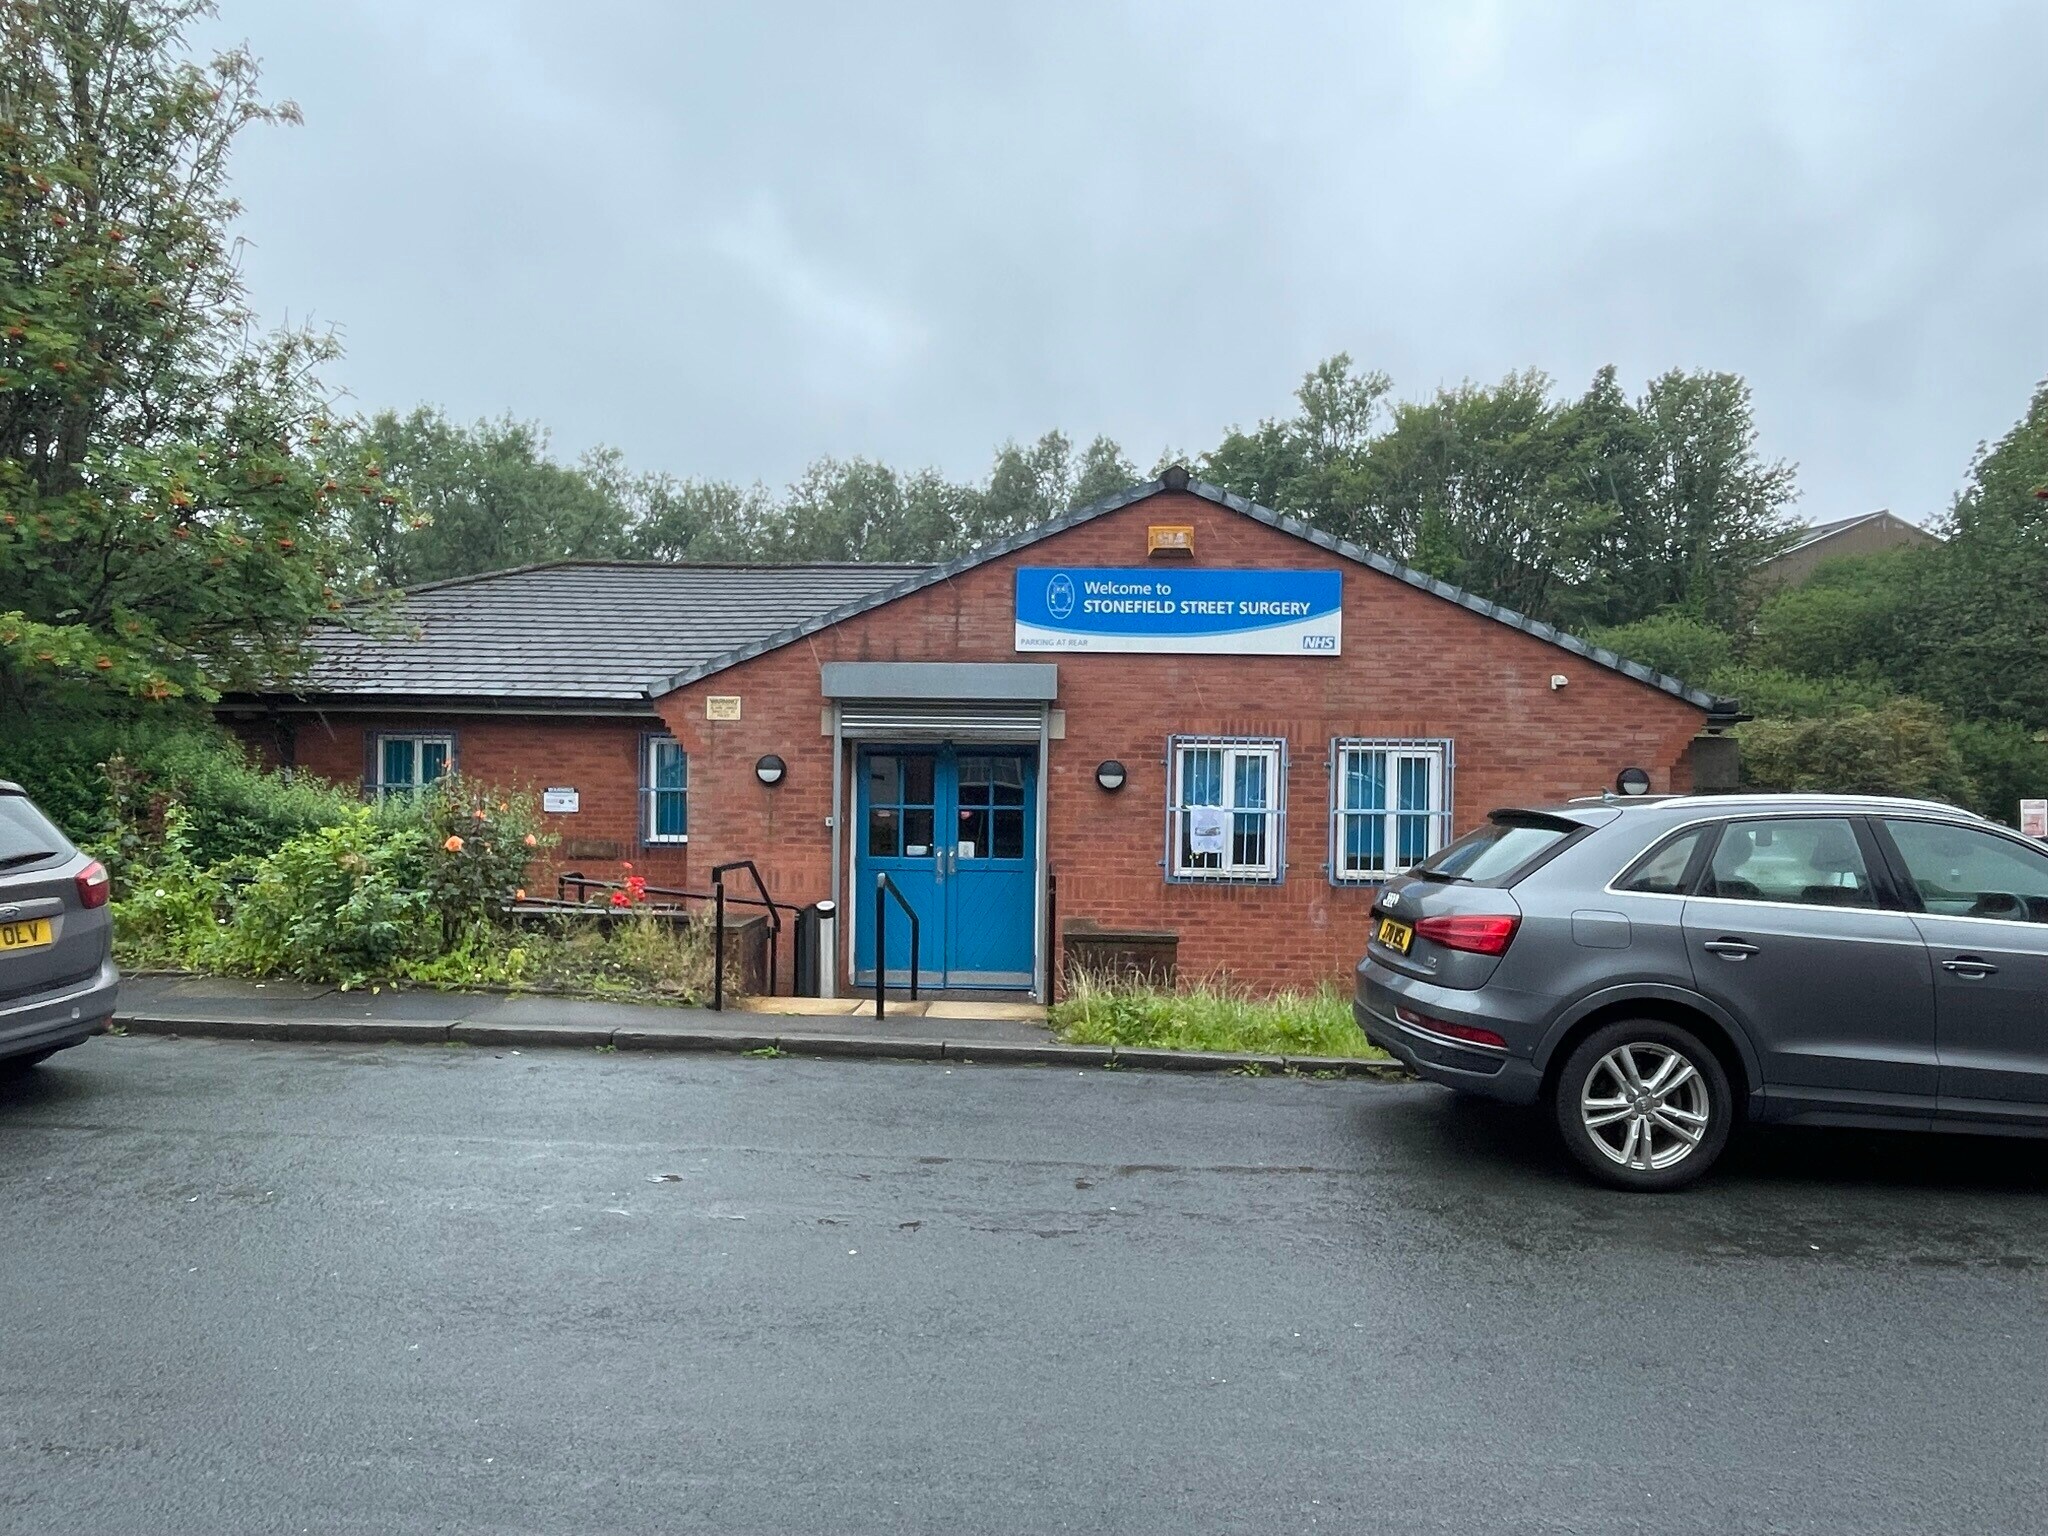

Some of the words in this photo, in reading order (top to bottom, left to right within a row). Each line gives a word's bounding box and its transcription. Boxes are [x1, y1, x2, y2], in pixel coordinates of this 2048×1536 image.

[1083, 581, 1152, 595] Welcome
[1156, 582, 1172, 595] to
[1083, 599, 1176, 614] STONEFIELD
[1180, 601, 1235, 615] STREET
[1238, 601, 1311, 615] SURGERY
[1020, 638, 1053, 646] PARKING
[1056, 639, 1067, 647] AT
[1068, 639, 1088, 647] REAR
[1303, 636, 1335, 649] NHS
